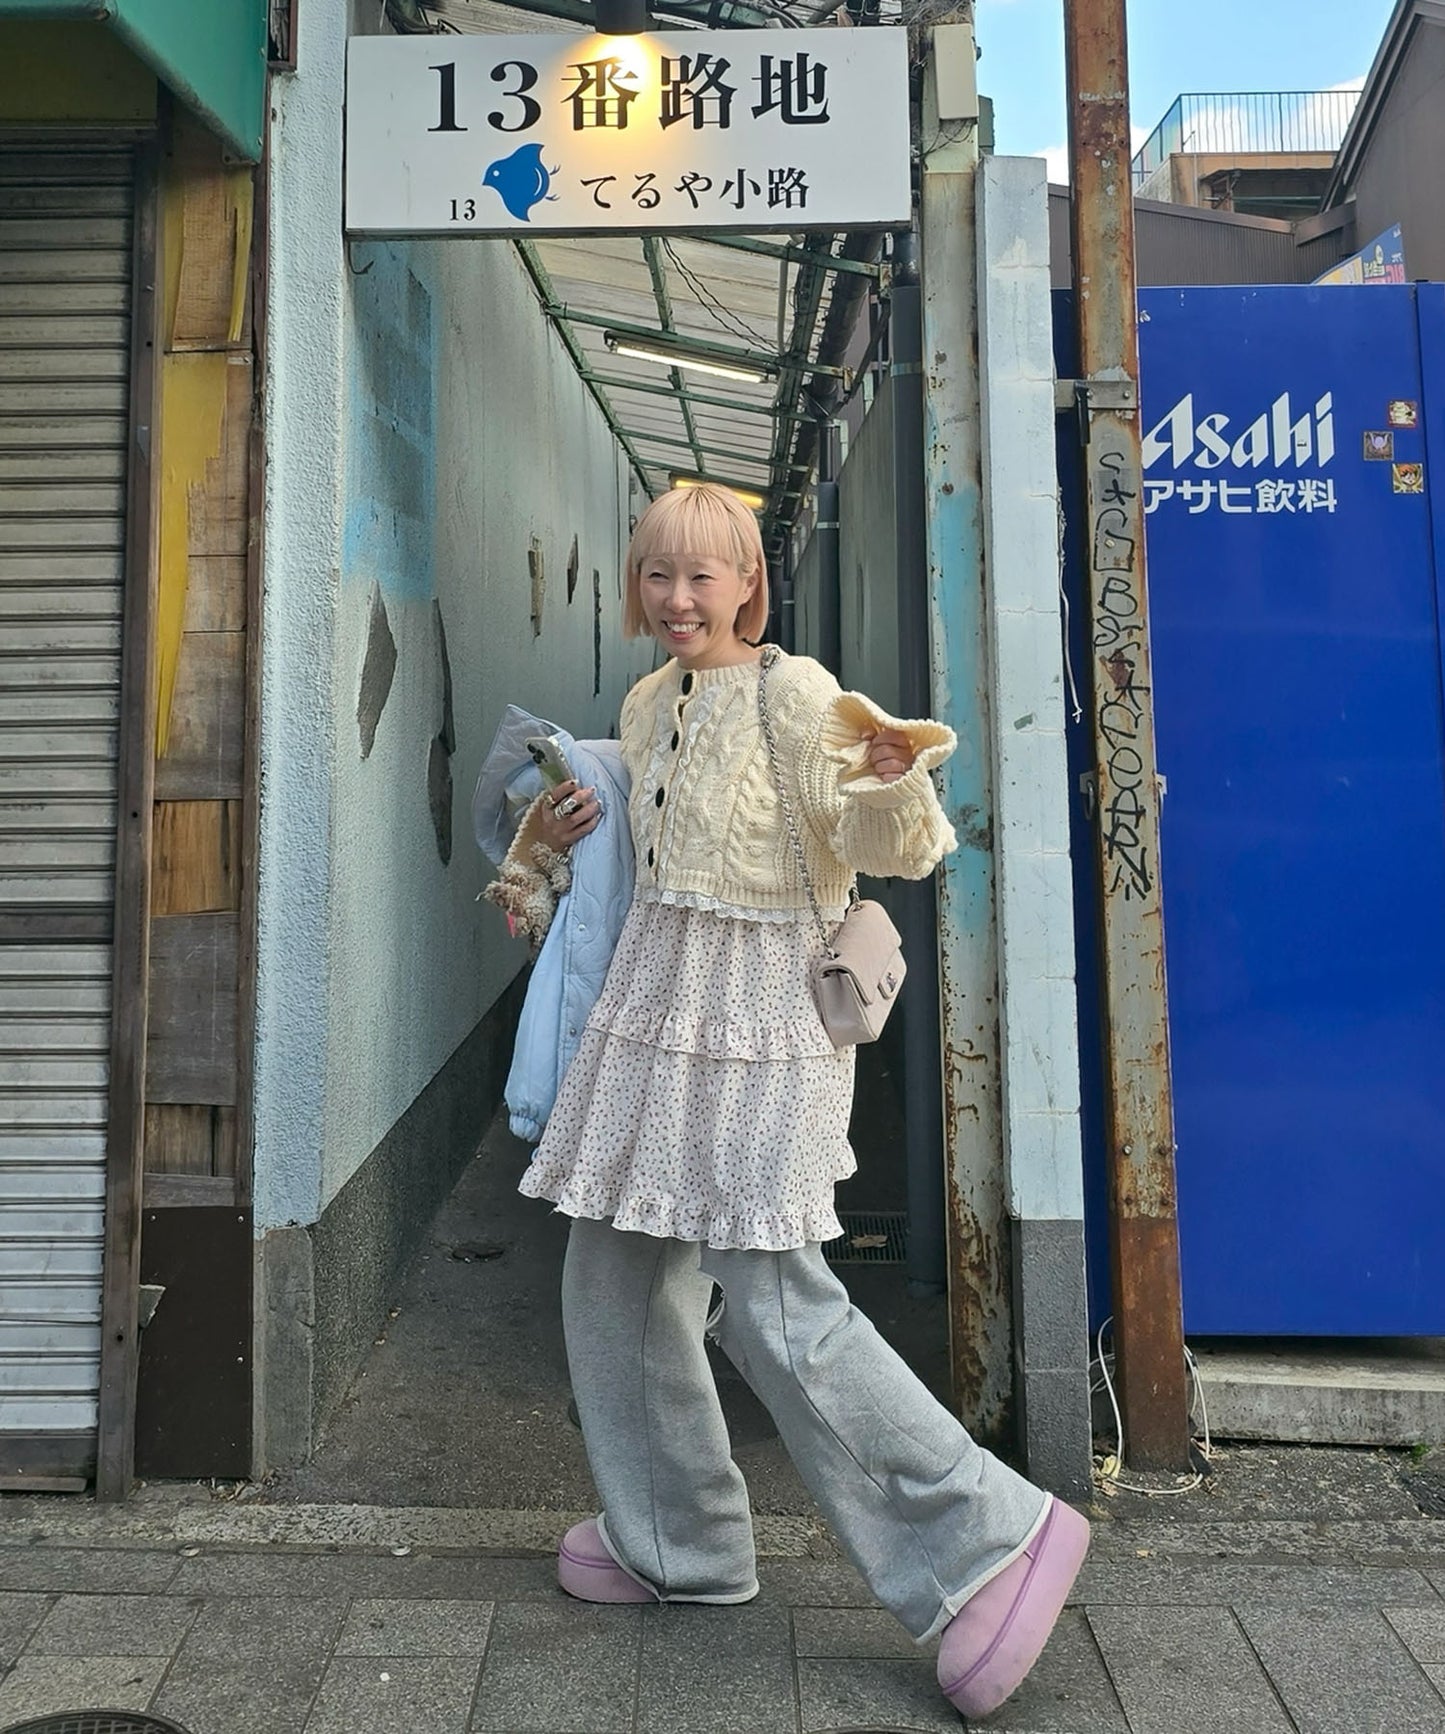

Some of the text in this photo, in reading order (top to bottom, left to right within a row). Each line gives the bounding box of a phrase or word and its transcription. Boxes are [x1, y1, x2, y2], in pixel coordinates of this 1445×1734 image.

[427, 53, 831, 132] 13番路地
[450, 198, 476, 221] 13
[580, 167, 809, 210] てるや小路
[1141, 391, 1335, 469] Asahi
[1143, 478, 1338, 514] アサヒ飲料
